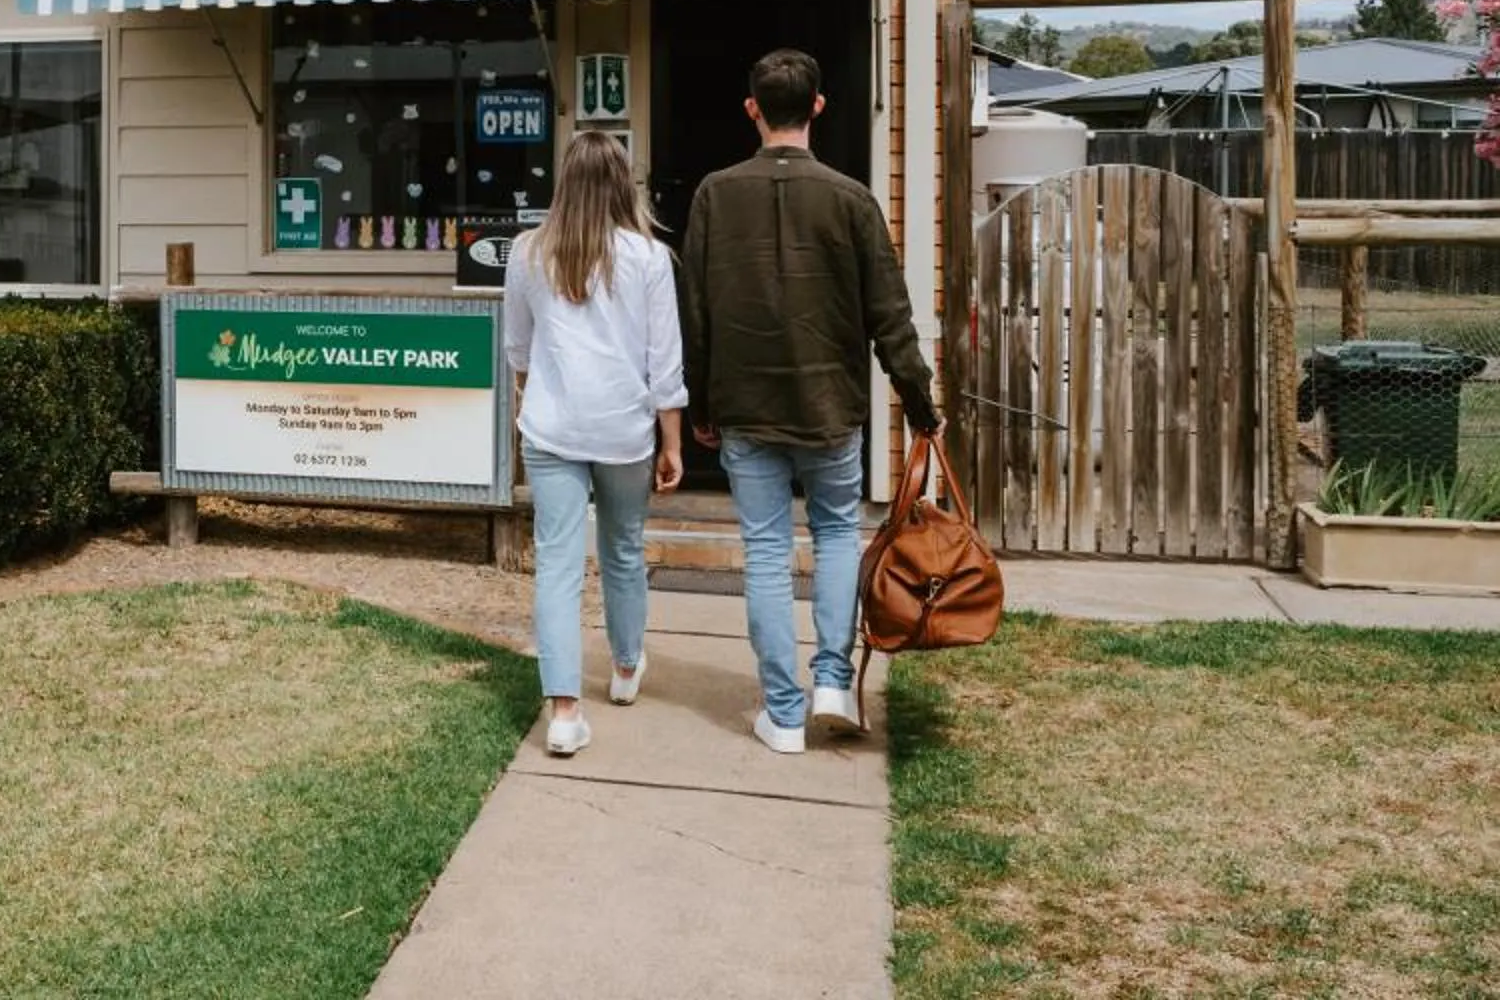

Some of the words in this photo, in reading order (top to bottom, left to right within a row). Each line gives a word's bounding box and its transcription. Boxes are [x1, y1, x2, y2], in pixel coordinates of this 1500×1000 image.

[483, 110, 540, 136] OPEN
[296, 325, 349, 336] WELCOME
[351, 325, 367, 337] TO
[237, 332, 319, 379] Mudgee
[321, 347, 399, 367] VALLEY
[403, 349, 460, 369] PARK
[245, 403, 288, 415] Monday
[290, 404, 301, 414] to
[303, 404, 351, 417] Saturday
[353, 406, 377, 417] 9am
[380, 407, 391, 418] to
[393, 408, 417, 420] 5pm
[279, 417, 317, 430] Sunday
[321, 418, 343, 430] 9am
[346, 420, 357, 430] to
[293, 453, 308, 464] 02
